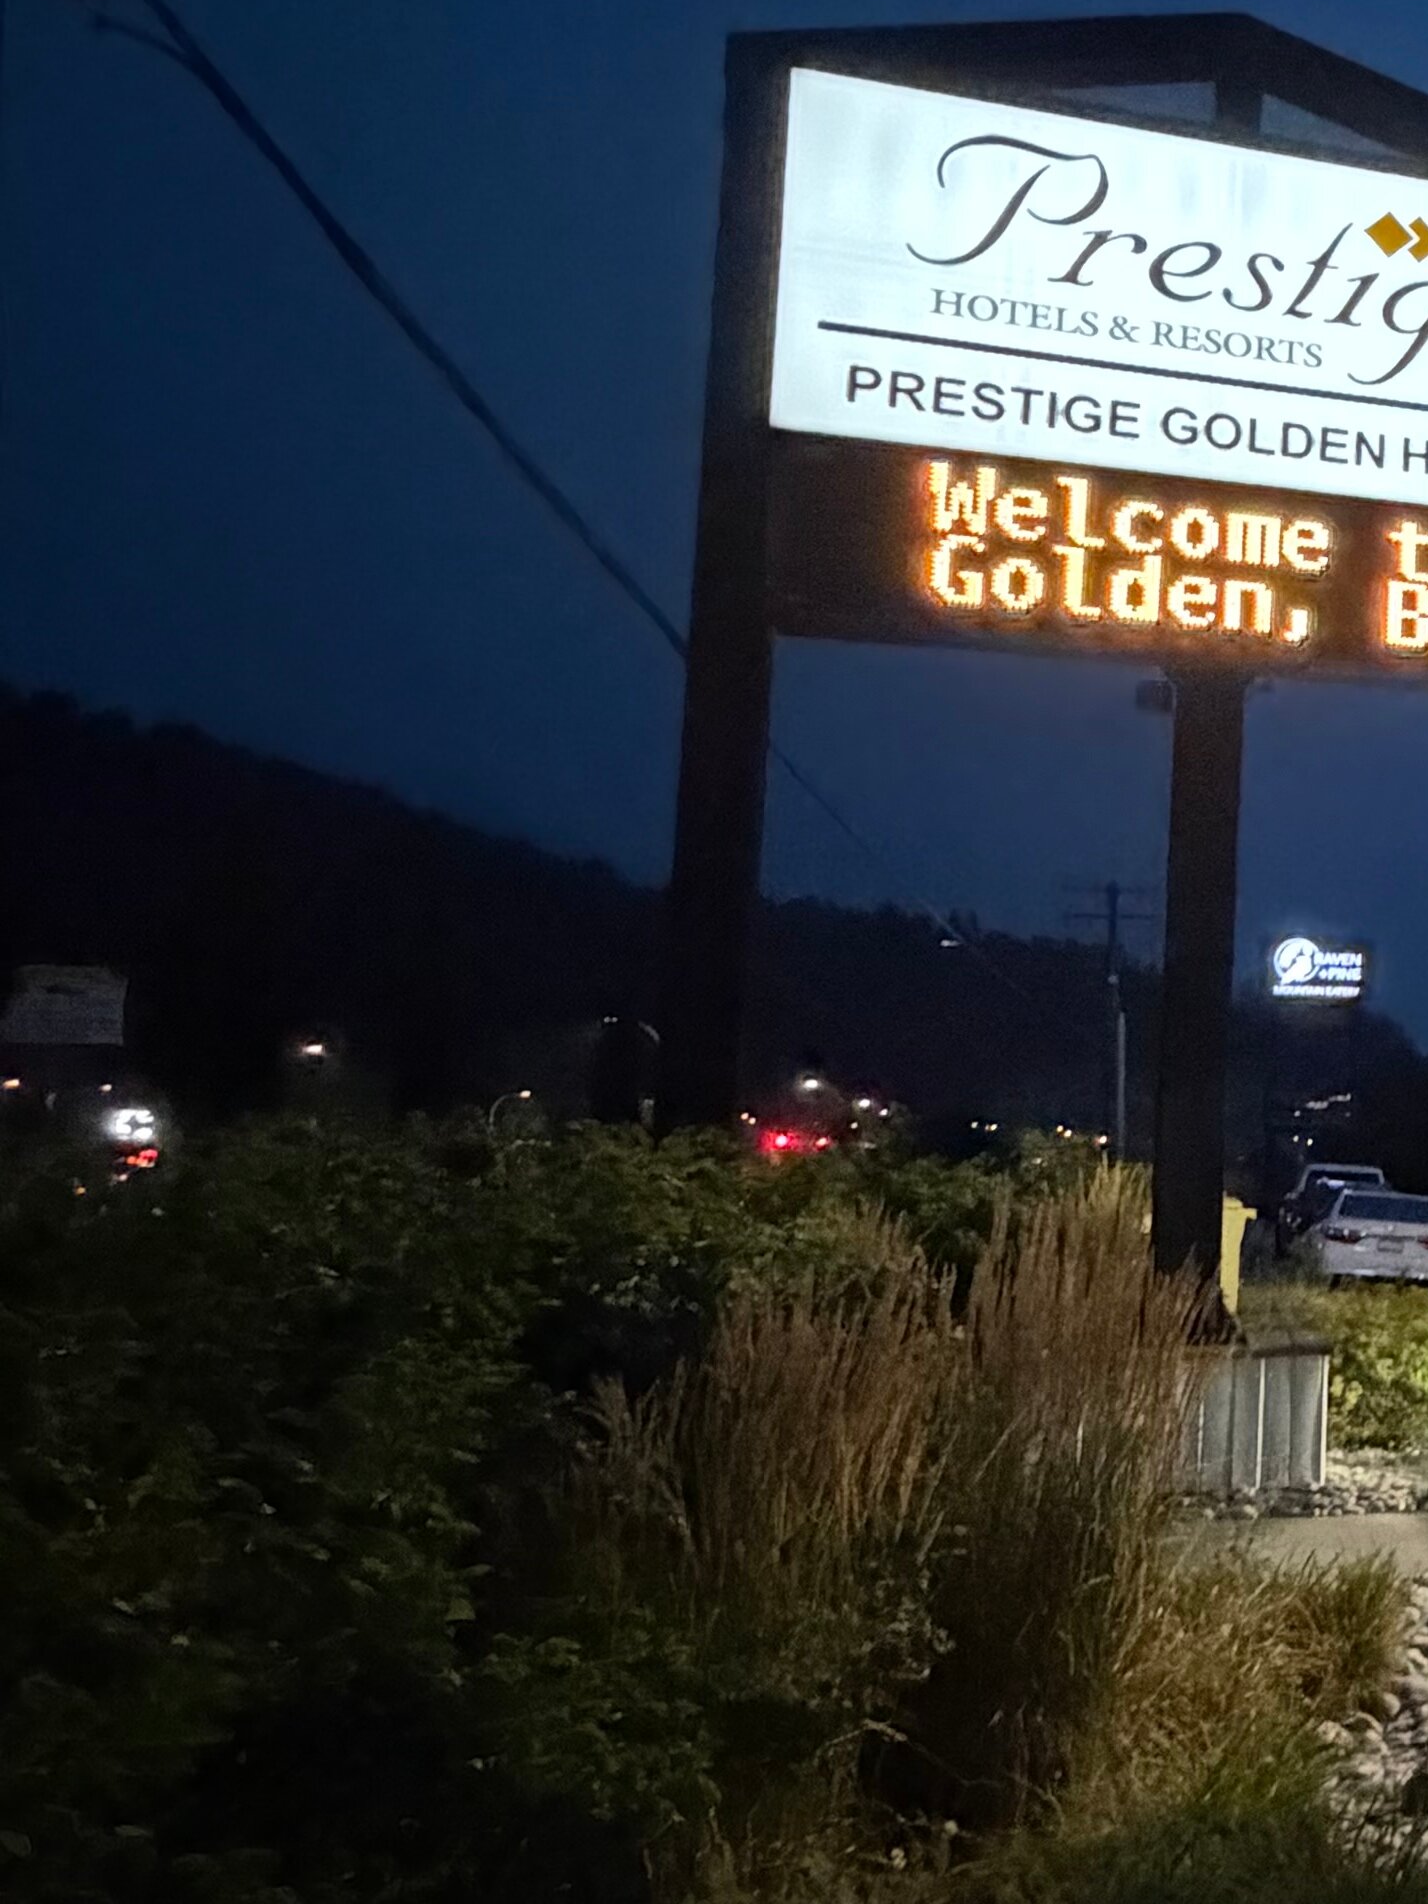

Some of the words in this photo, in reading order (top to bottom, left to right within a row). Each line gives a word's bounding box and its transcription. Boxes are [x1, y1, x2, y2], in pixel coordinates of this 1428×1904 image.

[930, 287, 1099, 340] HOTELS
[1110, 311, 1140, 343] &
[1152, 321, 1324, 369] RESORTS
[846, 365, 1142, 439] PRESTIGE
[1161, 407, 1386, 469] GOLDEN
[926, 460, 1331, 577] Welcome
[928, 535, 1312, 646] Golden,
